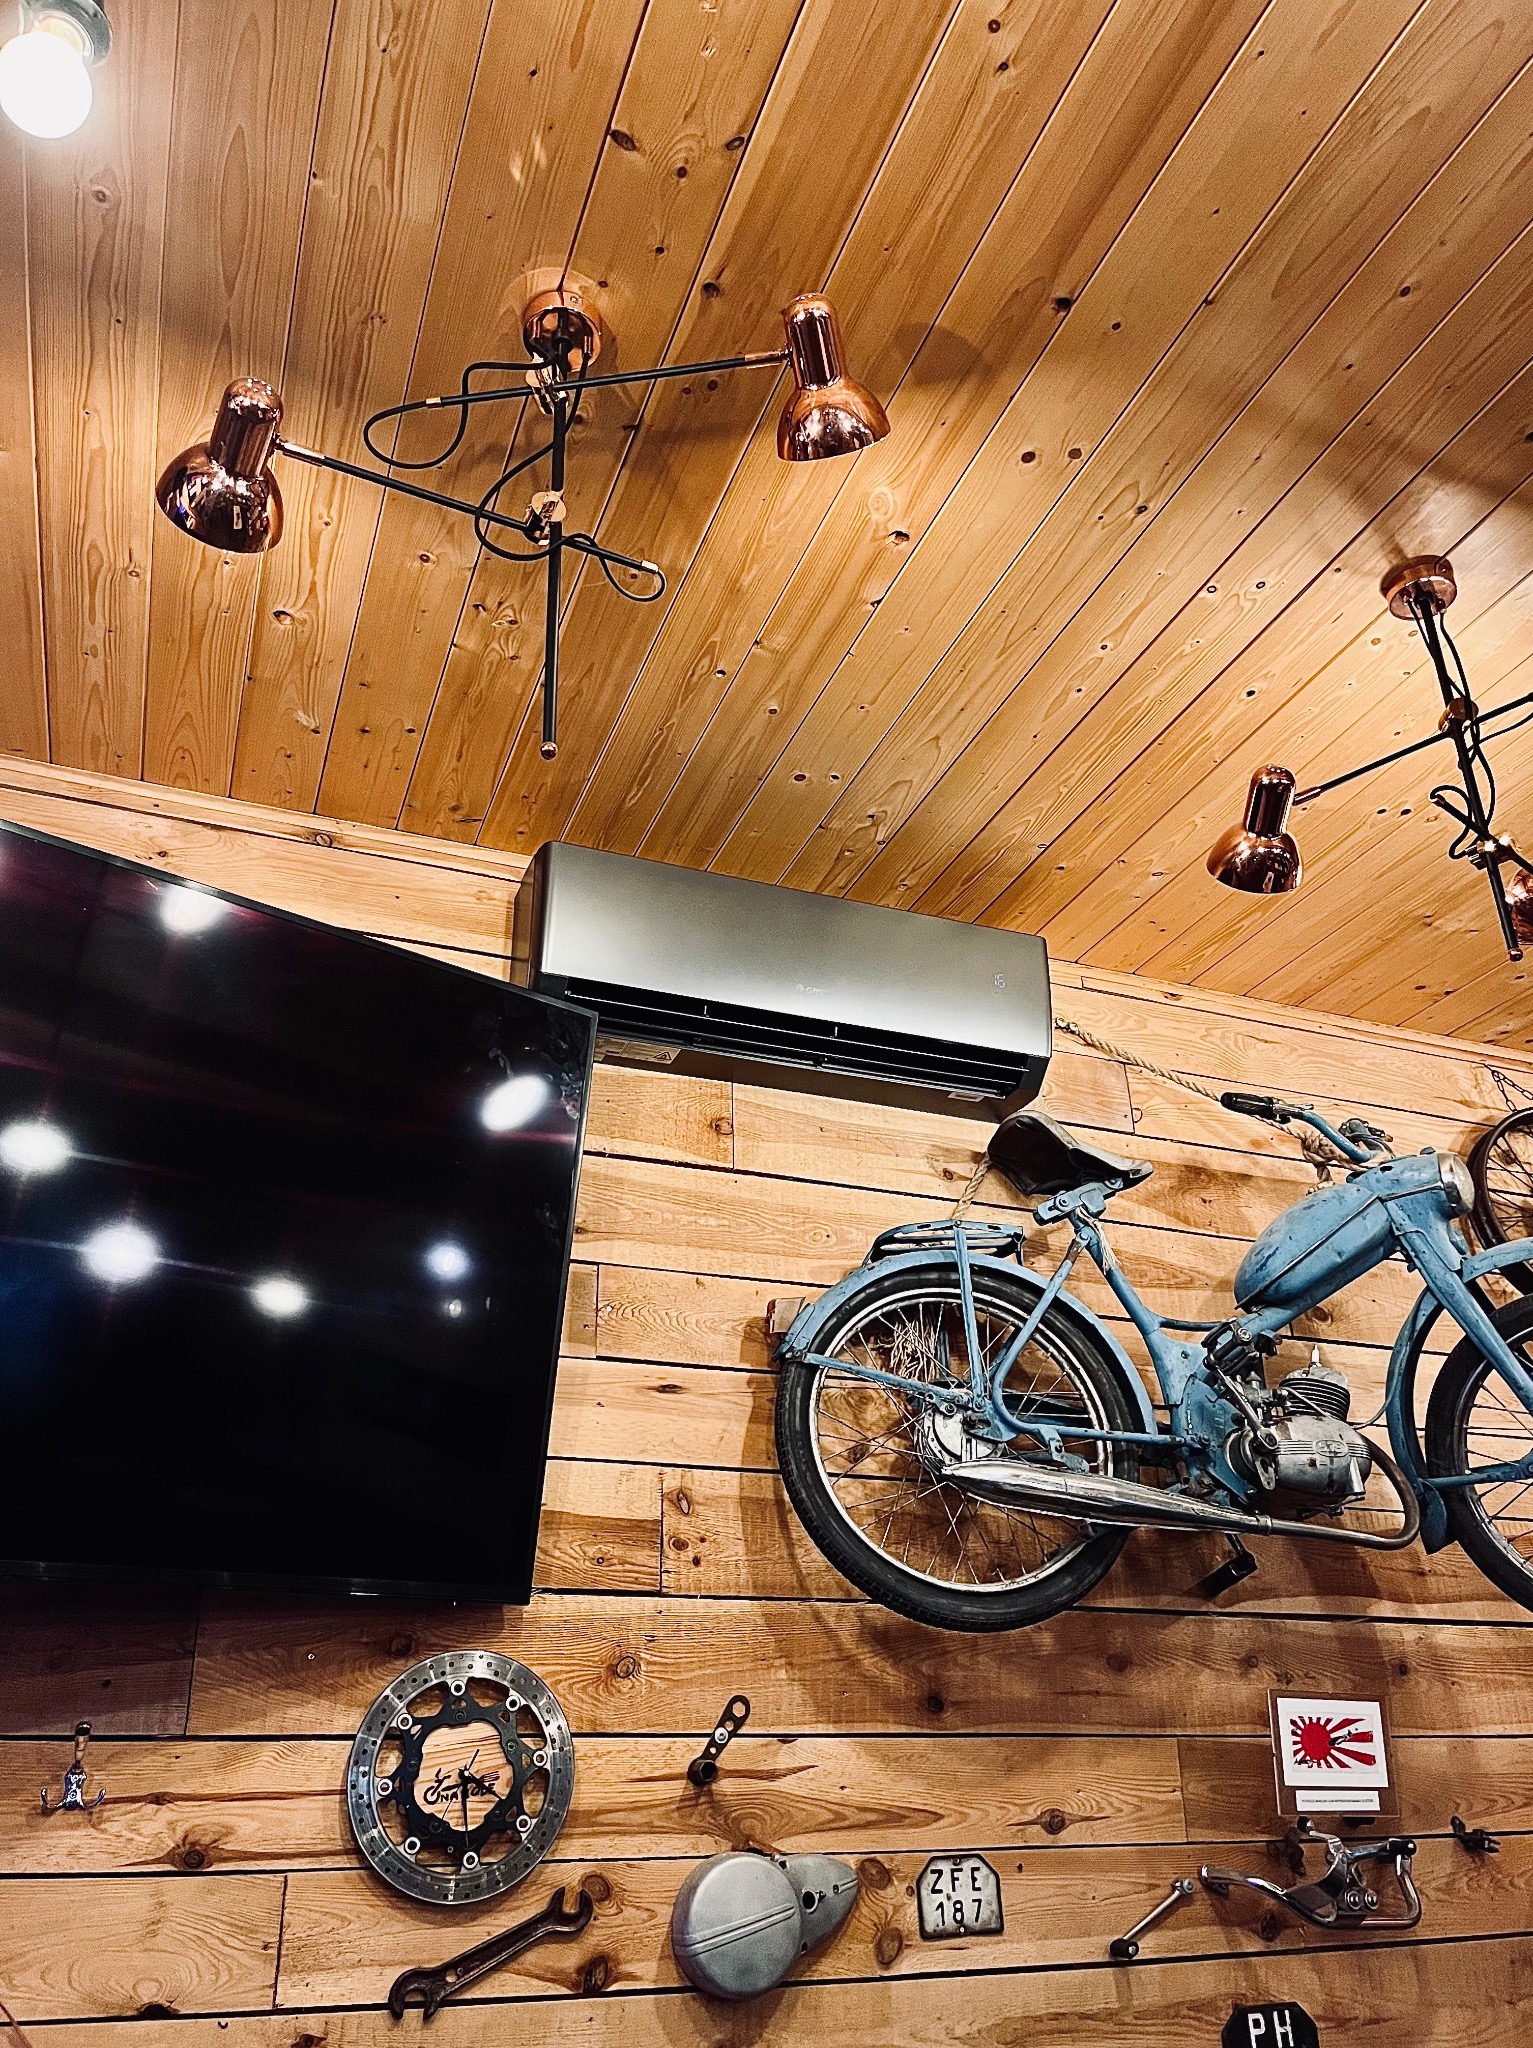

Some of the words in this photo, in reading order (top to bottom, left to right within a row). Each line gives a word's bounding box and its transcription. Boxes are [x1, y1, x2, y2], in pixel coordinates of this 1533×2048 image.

[929, 1866, 982, 1895] ZFE
[935, 1898, 983, 1927] 187
[1247, 2009, 1295, 2048] PH
